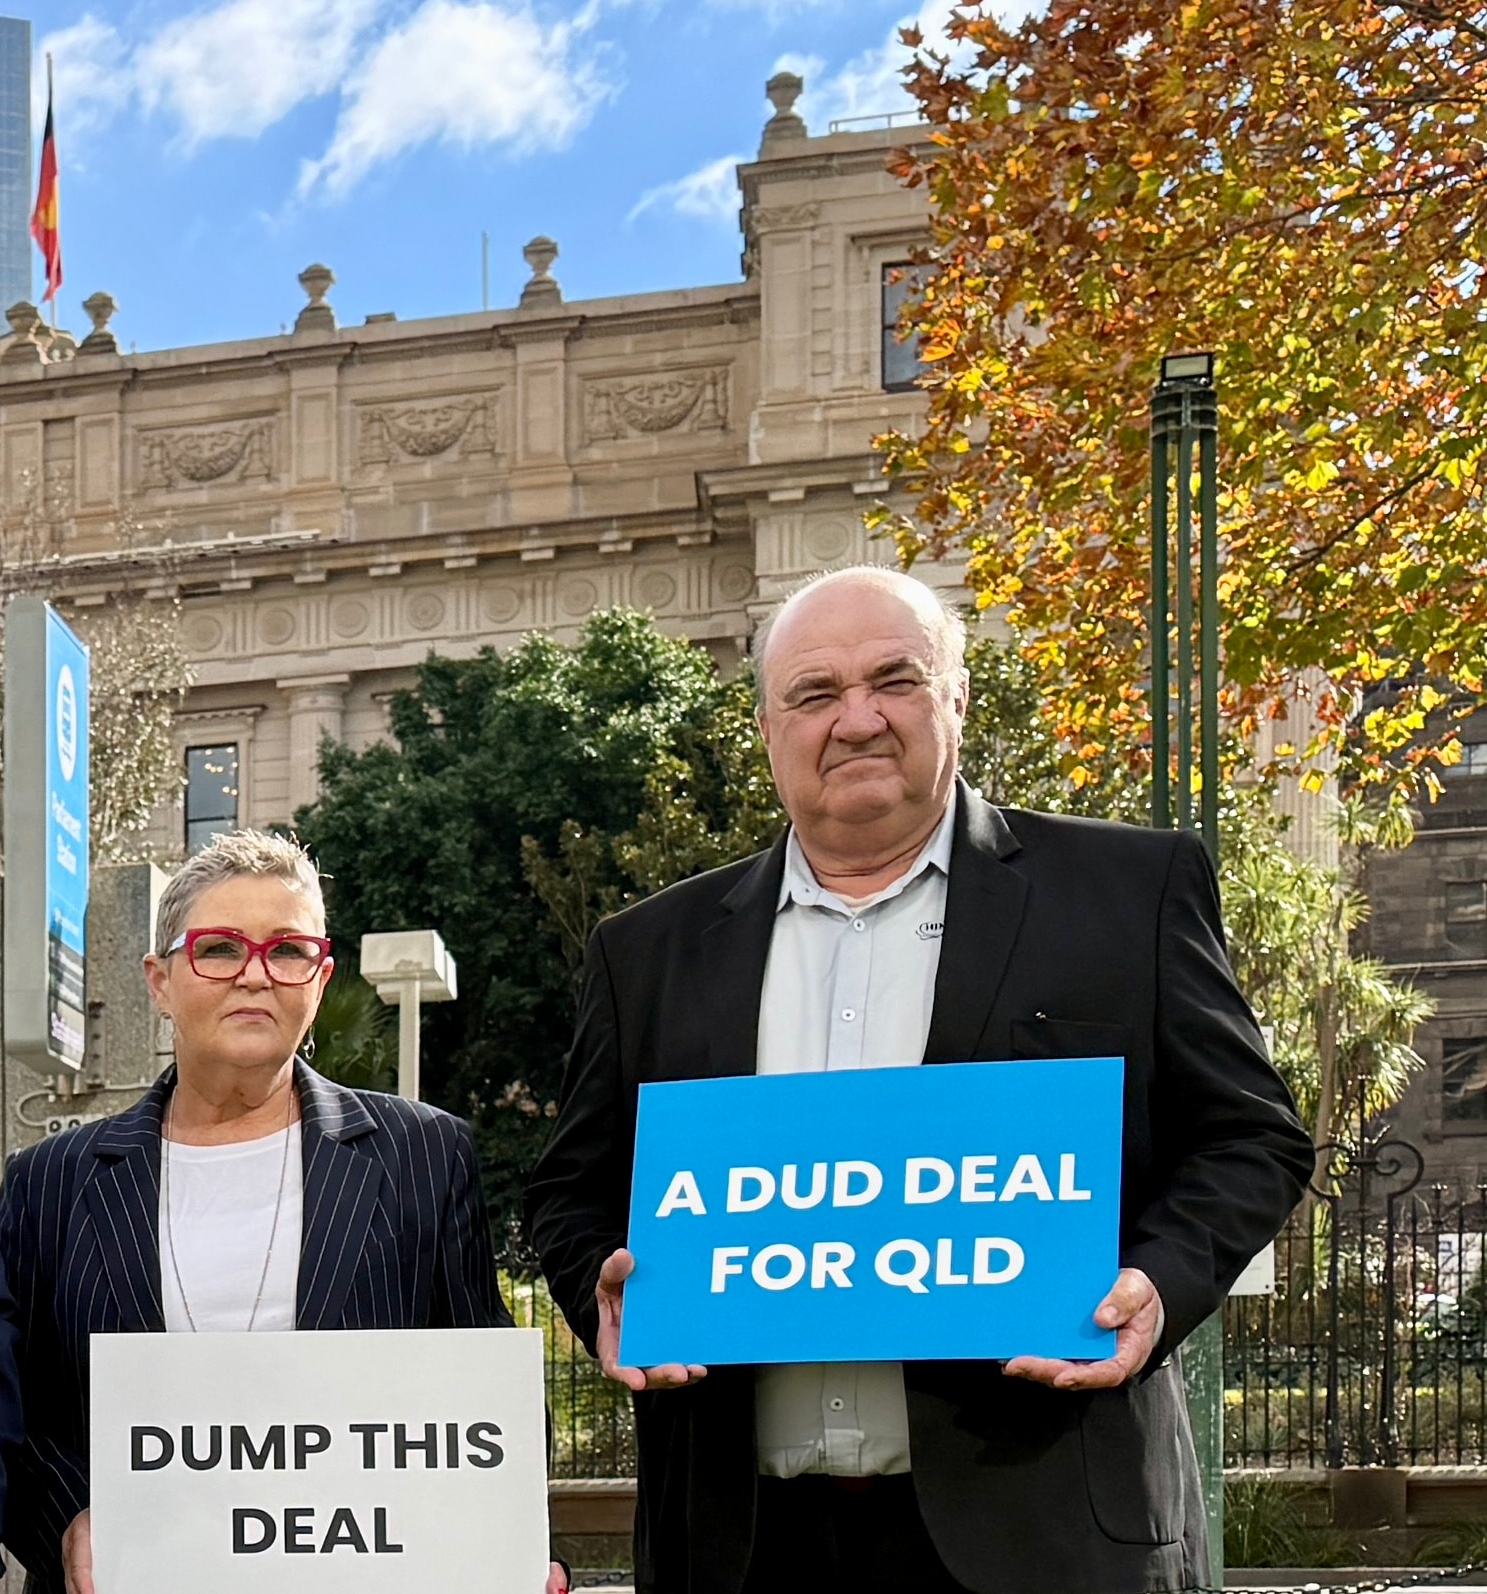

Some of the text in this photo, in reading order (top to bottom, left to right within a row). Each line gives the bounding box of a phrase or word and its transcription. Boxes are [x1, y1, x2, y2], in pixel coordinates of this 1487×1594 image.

[656, 1154, 1091, 1217] A DUD DEAL
[711, 1237, 1024, 1293] FOR QLD
[131, 1422, 503, 1471] DUMP THIS
[233, 1508, 403, 1553] DEAL
